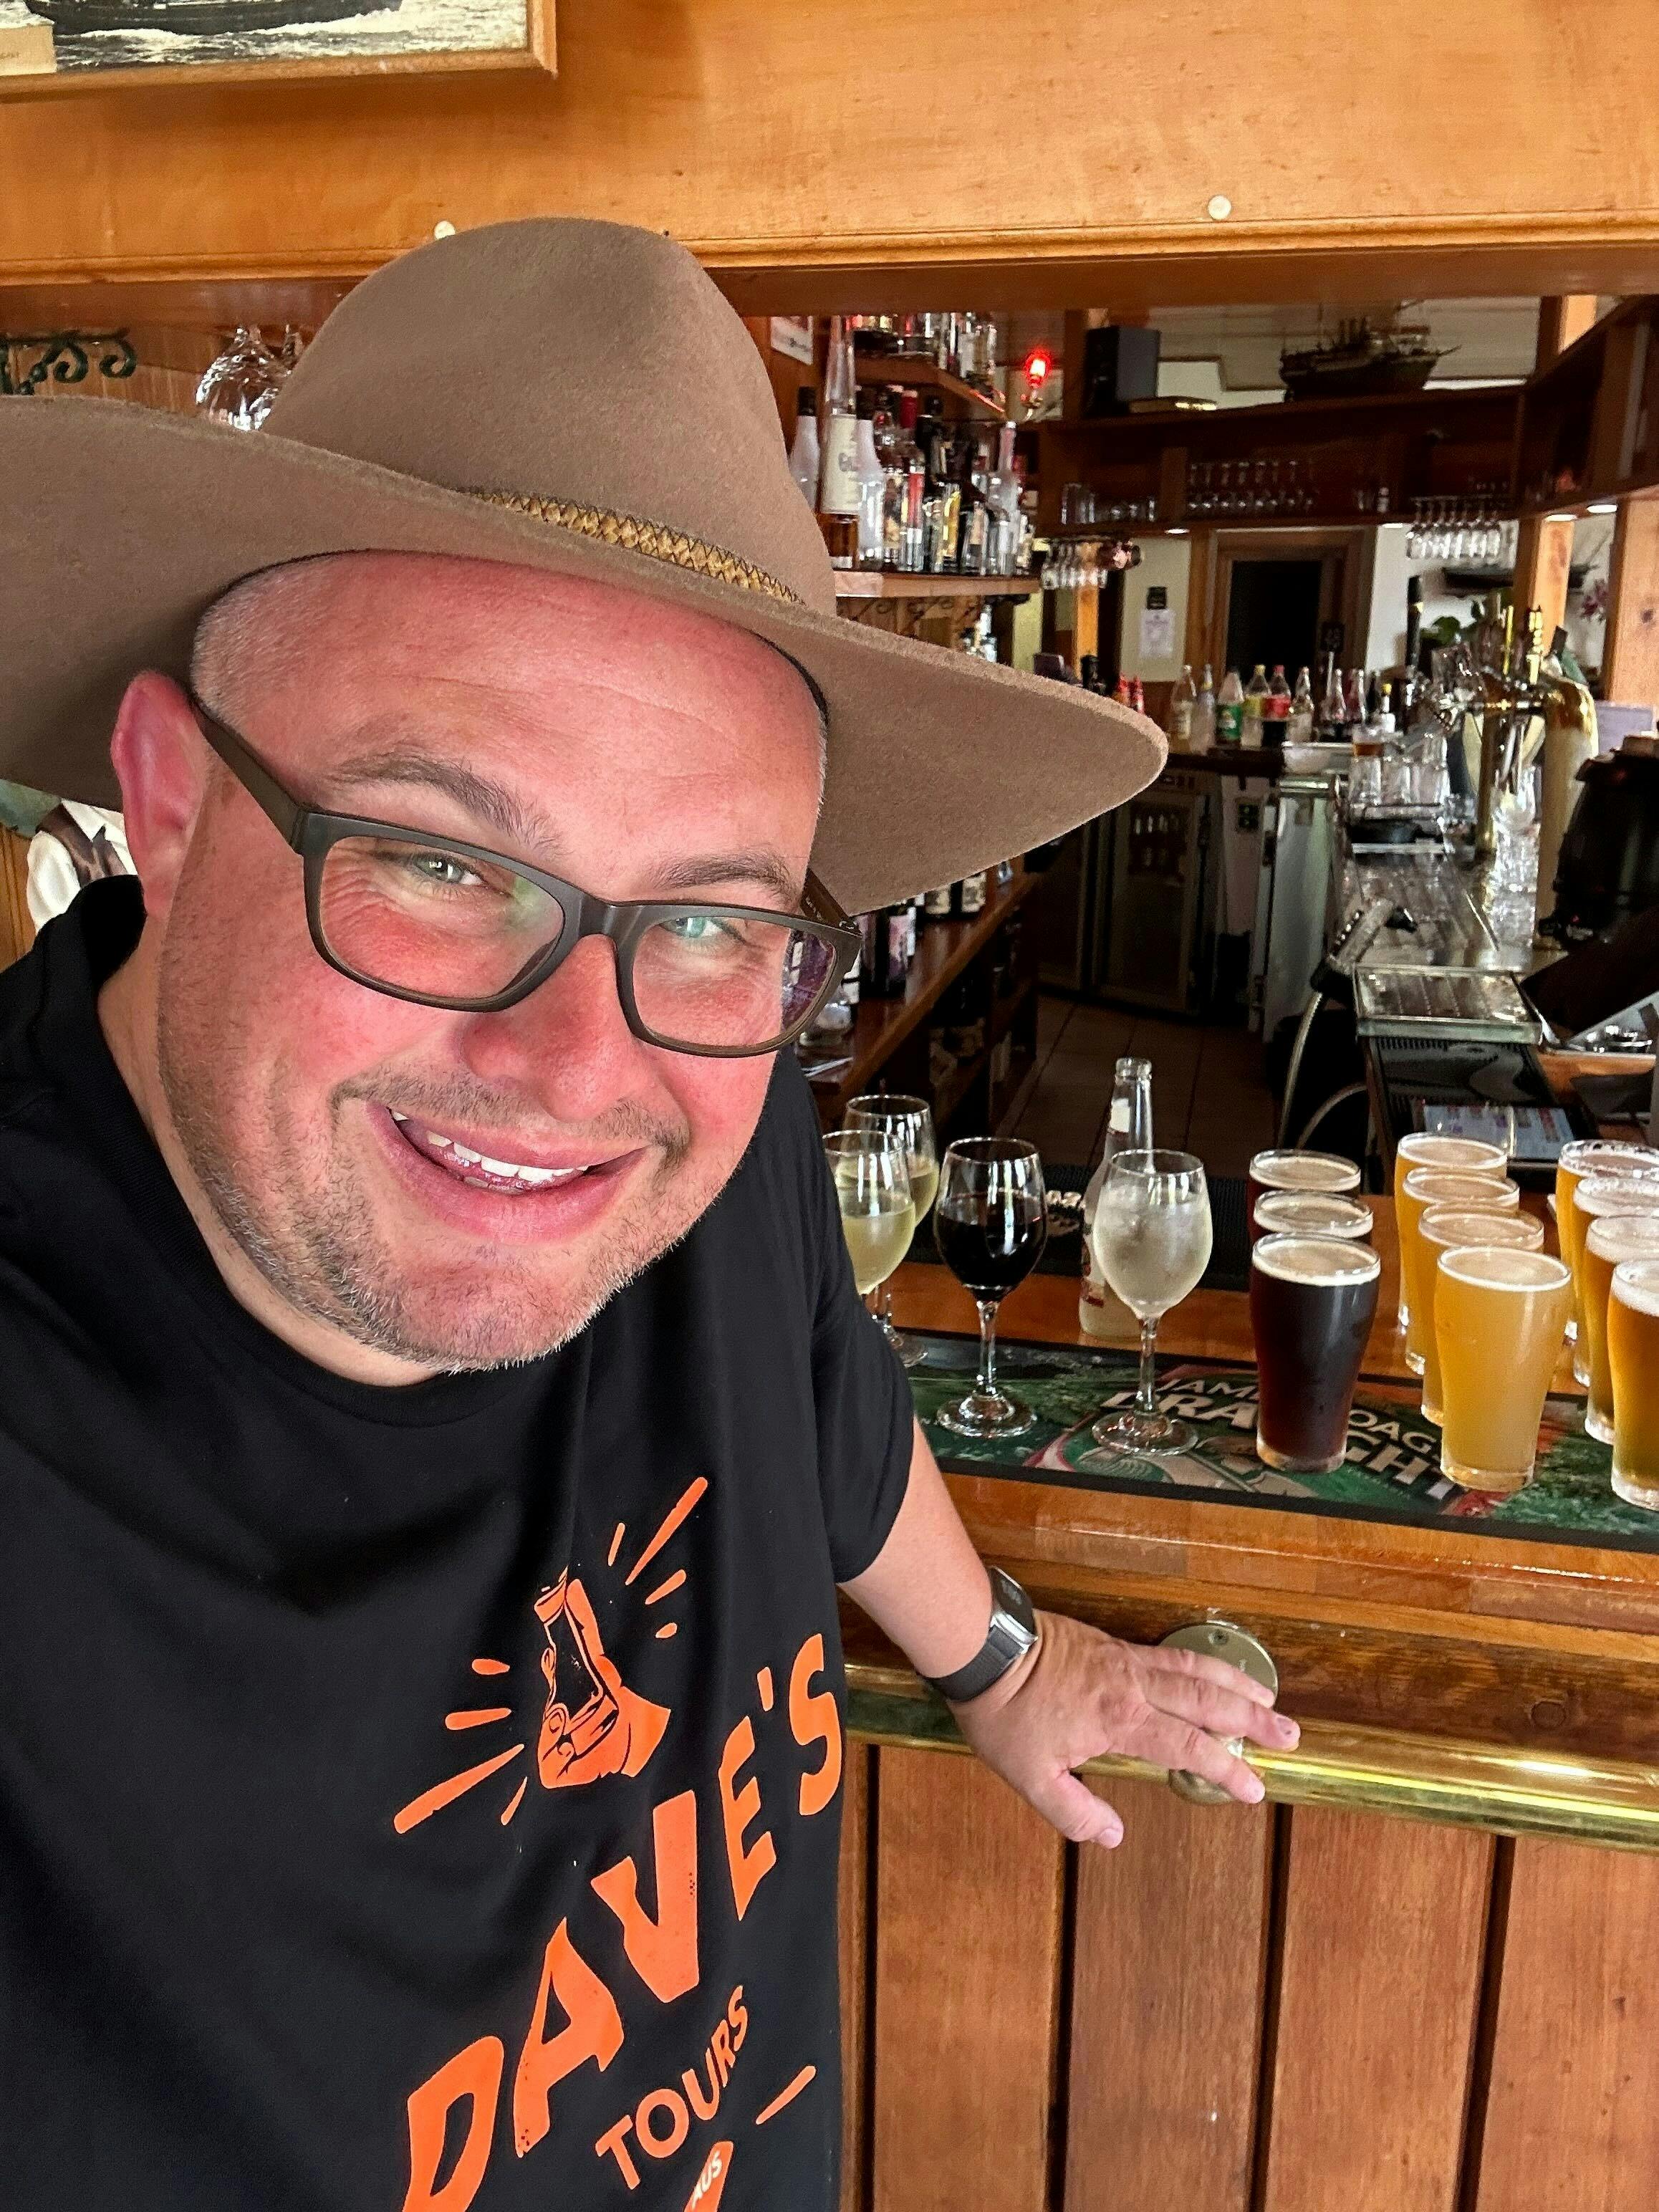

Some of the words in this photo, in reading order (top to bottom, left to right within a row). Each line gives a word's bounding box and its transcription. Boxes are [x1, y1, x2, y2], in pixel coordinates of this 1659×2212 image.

[1155, 1379, 1261, 1400] JAM
[398, 1633, 842, 2212] DAVE'S
[595, 1986, 749, 2190] TOURS
